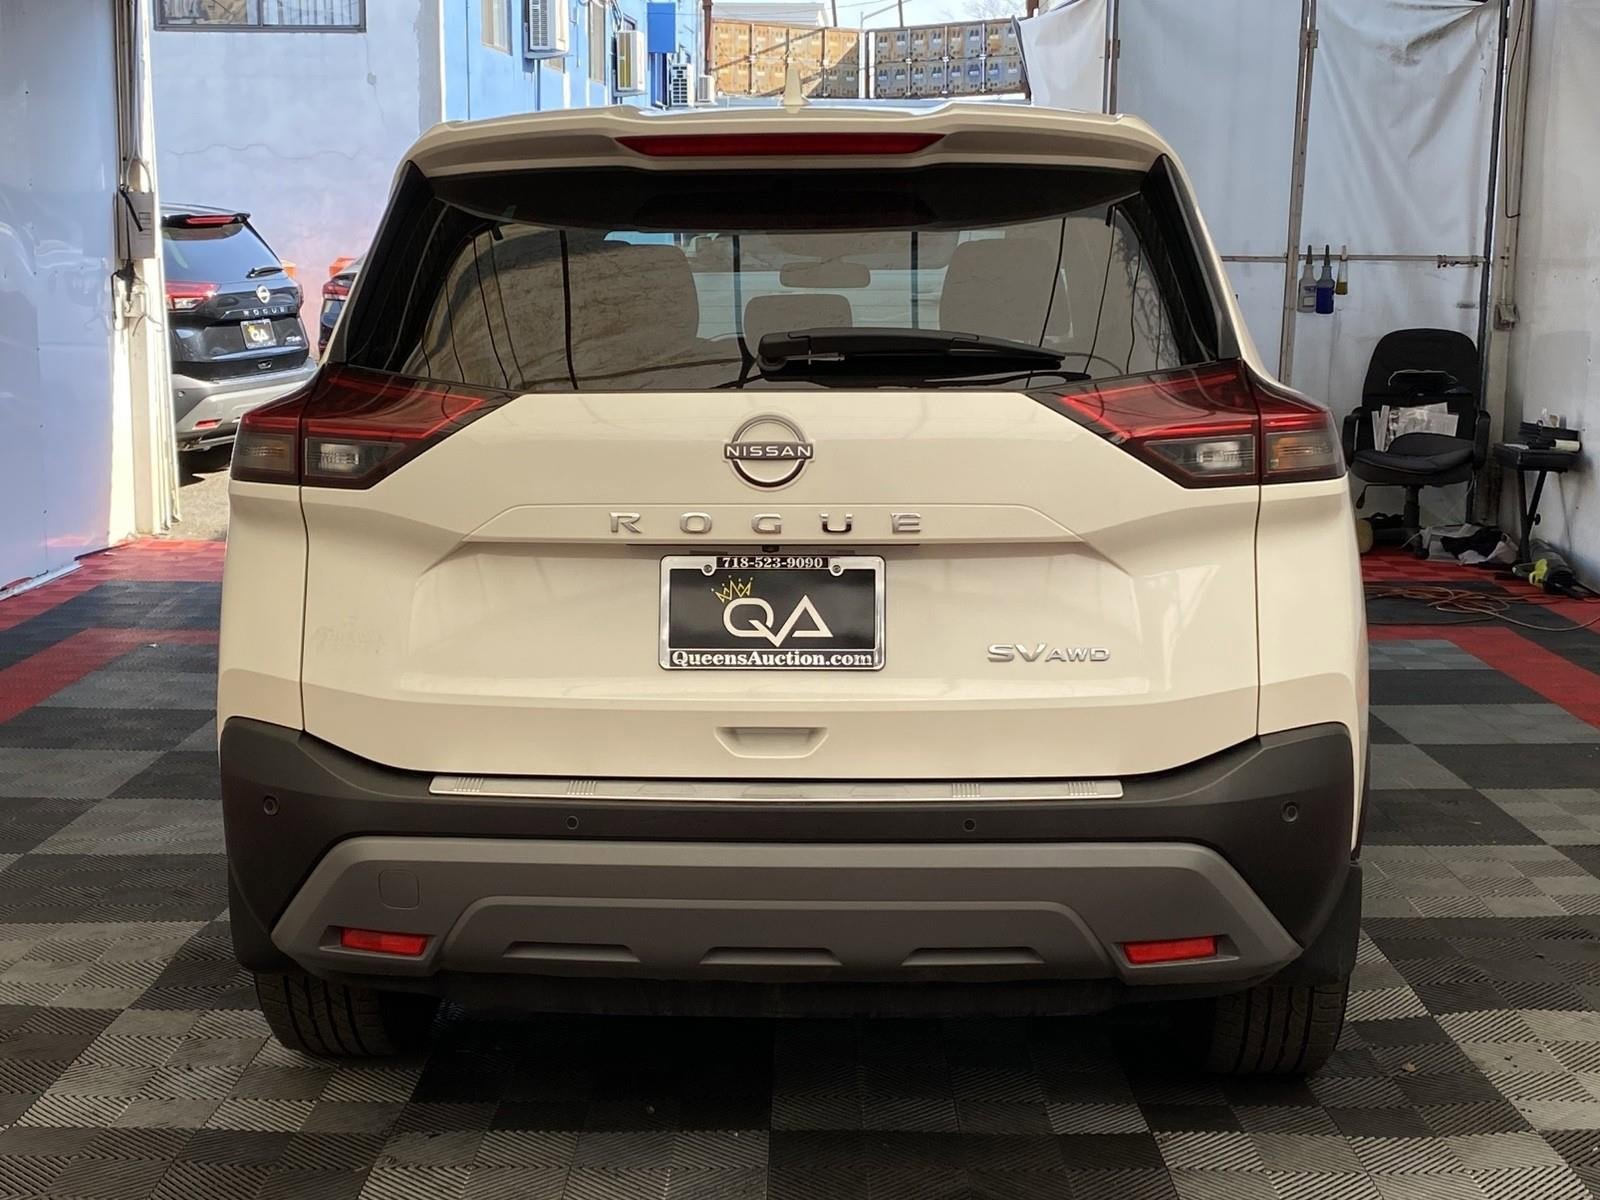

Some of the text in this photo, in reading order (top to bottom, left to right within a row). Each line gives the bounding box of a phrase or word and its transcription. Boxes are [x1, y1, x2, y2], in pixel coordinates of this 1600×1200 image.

[726, 445, 812, 457] NISSAN
[609, 511, 922, 534] ROGUE
[722, 556, 823, 569] 718-523-9090
[672, 651, 873, 669] QueensAuction.com
